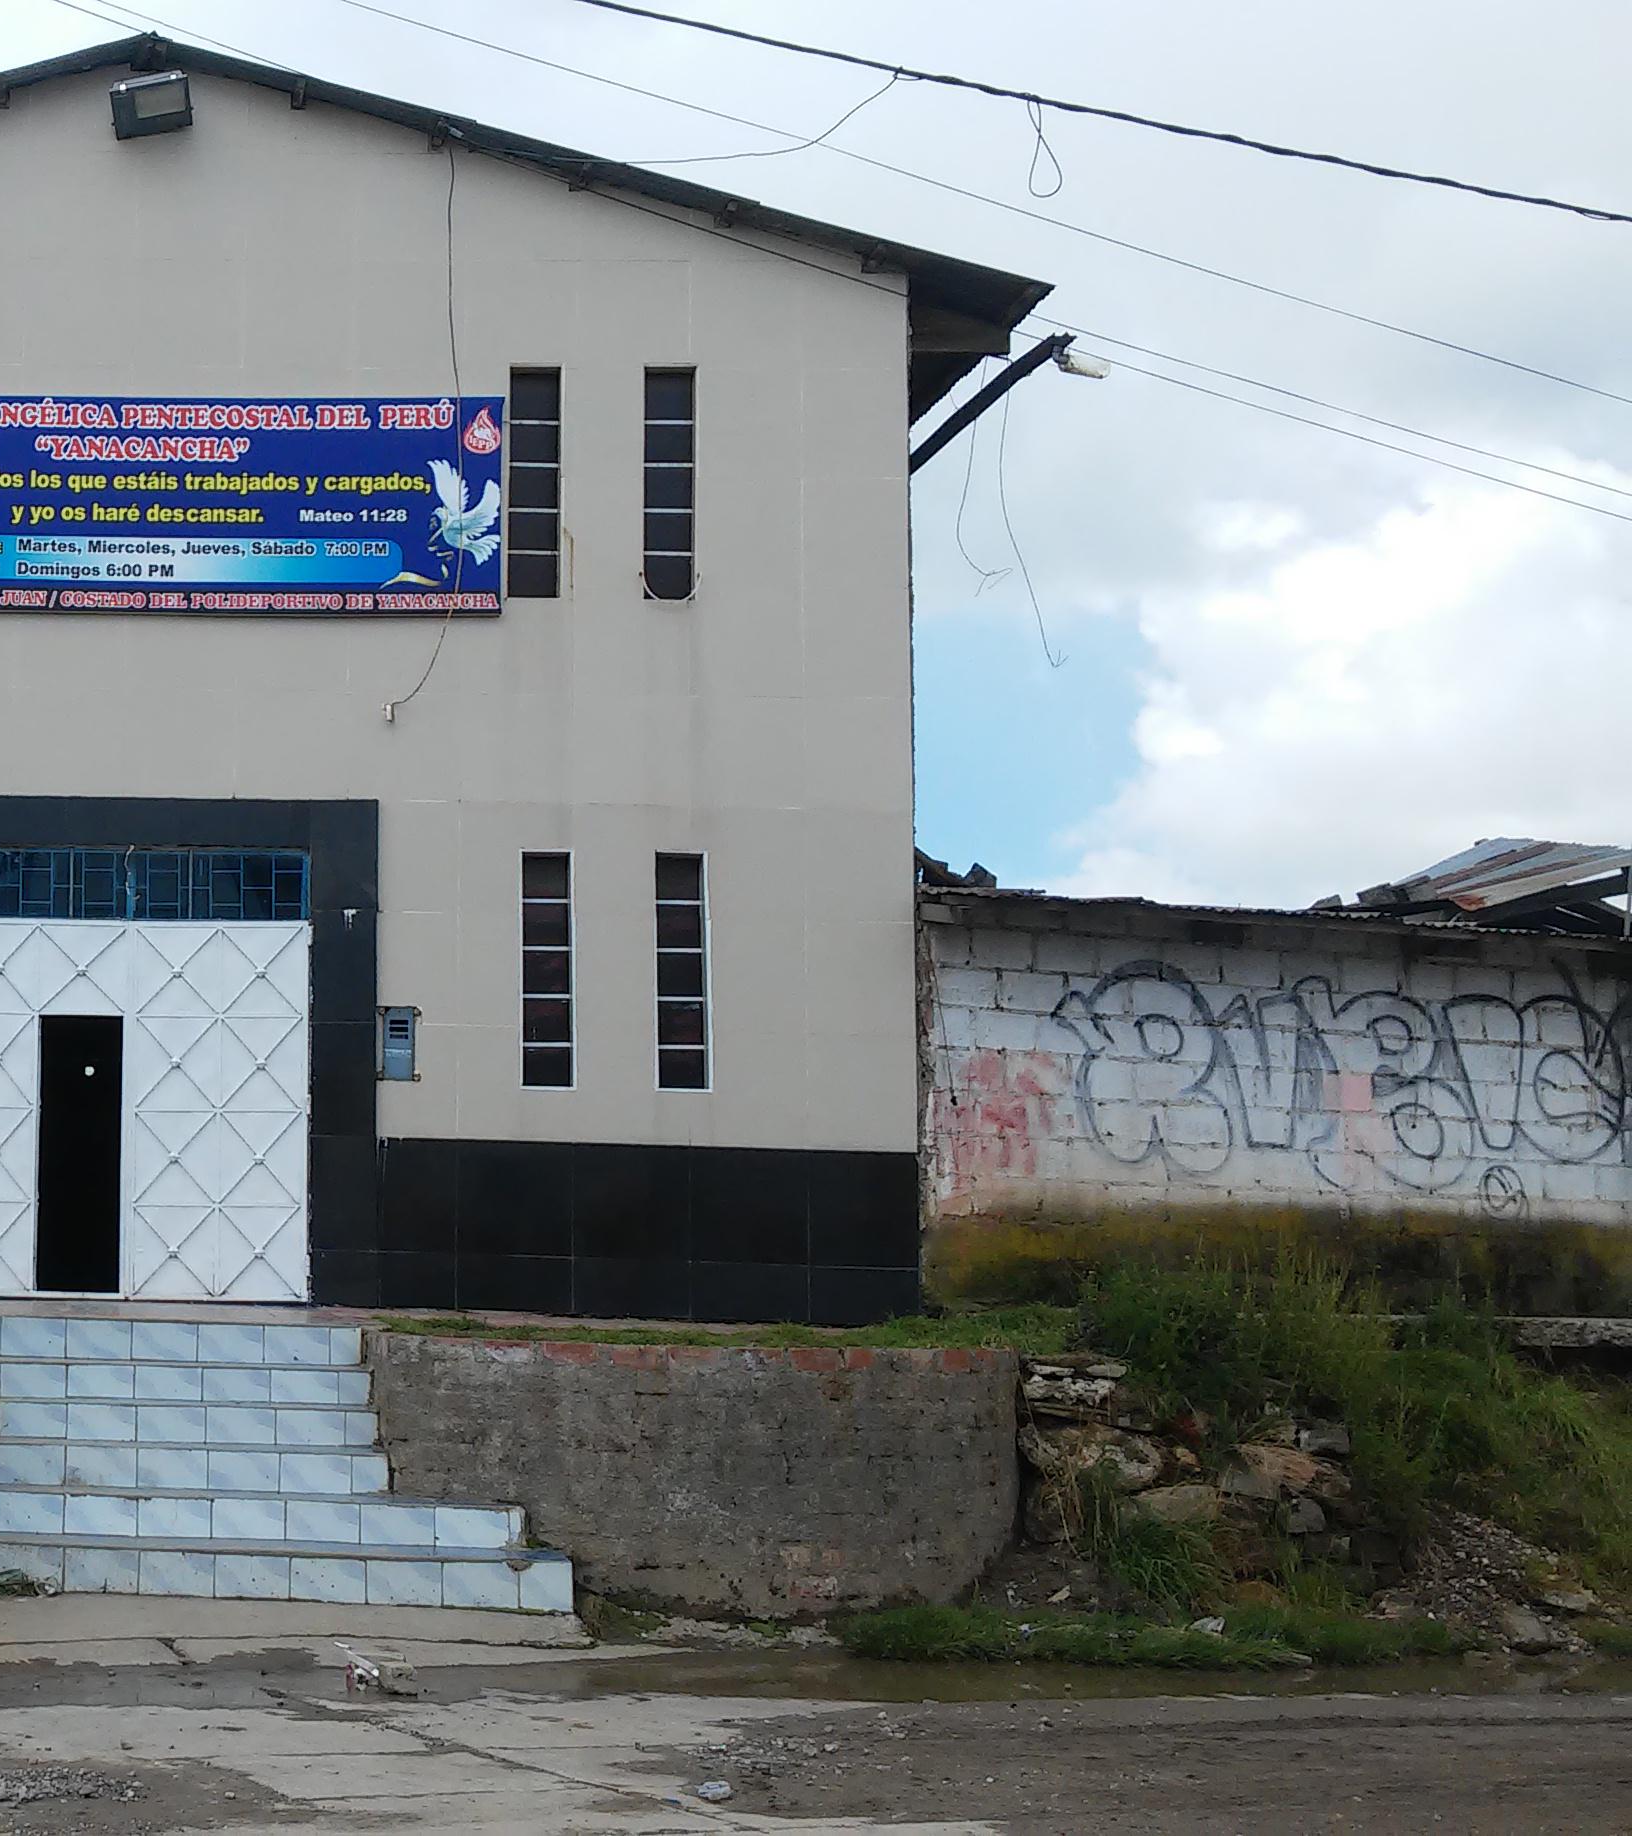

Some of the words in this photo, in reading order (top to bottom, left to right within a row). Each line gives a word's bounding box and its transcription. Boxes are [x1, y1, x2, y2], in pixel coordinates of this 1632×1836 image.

[121, 404, 312, 430] PENTECOSTAL
[317, 405, 370, 430] DEL
[378, 398, 454, 429] PERÚ
[30, 470, 62, 488] los
[68, 475, 107, 493] que
[113, 471, 178, 490] estáis
[184, 472, 299, 495] trabajados
[306, 476, 318, 495] y
[324, 472, 431, 495] cargados,
[11, 506, 24, 524] y
[30, 506, 54, 524] yo
[61, 506, 86, 521] os
[92, 503, 140, 522] haré
[146, 503, 264, 524] descansar.
[299, 508, 354, 522] Mateo
[359, 509, 407, 522] 11:28
[17, 538, 82, 555] Martes,
[181, 541, 246, 557] Jueves,
[252, 541, 316, 556] Sábado
[325, 542, 358, 556] 7:00
[363, 542, 388, 556] PM
[17, 561, 100, 578] Domingos
[106, 564, 142, 578] 6:00
[148, 564, 174, 578] PM
[60, 592, 148, 608] COSTADO
[149, 593, 188, 609] DEL
[190, 593, 345, 610] POLIDEPORTIVO
[346, 594, 374, 609] DE
[376, 594, 498, 609] YANACANCHA
